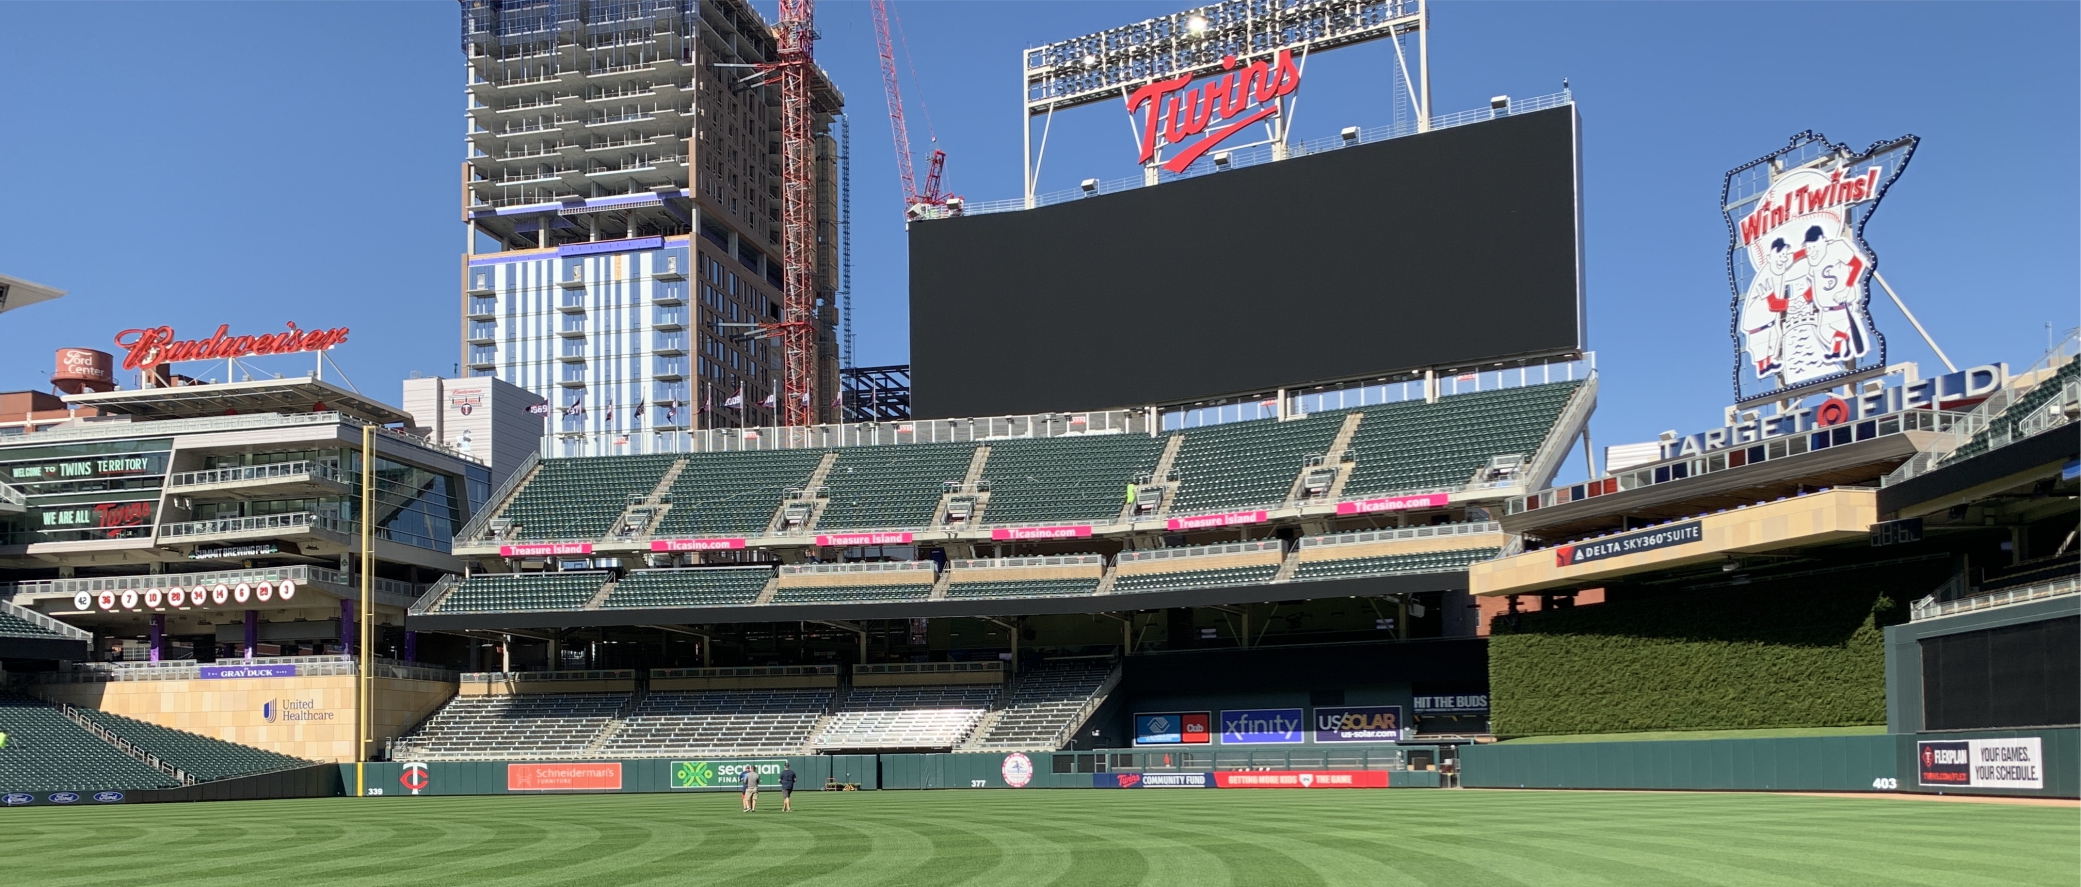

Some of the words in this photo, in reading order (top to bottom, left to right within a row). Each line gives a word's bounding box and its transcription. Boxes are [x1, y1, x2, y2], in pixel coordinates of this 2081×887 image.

[1127, 49, 1299, 173] Twins
[1740, 192, 1793, 245] Win!
[1797, 168, 1876, 214] Twins!
[114, 321, 349, 370] Budweiser
[63, 350, 93, 366] Ford
[68, 364, 105, 377] Center
[1659, 406, 1812, 460] TARGET
[1858, 365, 2003, 419] FIELD
[13, 466, 42, 477] WELCOME
[60, 461, 92, 477] TWINS
[97, 457, 148, 473] TERRITORY
[43, 512, 57, 526] WE
[58, 511, 74, 524] ARE
[75, 510, 90, 523] ALL
[94, 501, 151, 537] Twins
[1178, 518, 1222, 529] Treasure
[1225, 512, 1257, 524] Island
[826, 536, 870, 545] Treasure
[872, 534, 903, 544] Island
[196, 548, 222, 560] SUMMIT
[223, 546, 255, 558] BREWING
[256, 544, 270, 554] PUB
[510, 546, 551, 555] Treasure
[553, 544, 583, 554] Island
[1586, 542, 1621, 558] DELTA
[217, 590, 225, 599] 14
[240, 588, 245, 597] 6
[261, 587, 270, 596] 29
[285, 585, 290, 594] 3
[79, 596, 88, 605] 42
[103, 595, 112, 604] 36
[127, 595, 133, 603] 7
[150, 594, 158, 602] 10
[172, 592, 181, 601] 28
[195, 591, 204, 600] 34
[246, 669, 273, 677] DUCK
[282, 699, 314, 710] United
[1413, 696, 1432, 708] HIT
[1433, 696, 1455, 708] THE
[1456, 695, 1488, 708] BUDS
[282, 710, 334, 721] Healthcare
[1187, 723, 1204, 733] Cub
[1226, 714, 1299, 740] xfinity
[1341, 730, 1396, 738] us-solar.com
[1981, 747, 1999, 762] YOUR
[2001, 746, 2031, 762] GAMES.
[536, 767, 614, 778] Schneiderman's
[1975, 766, 1995, 780] YOUR
[1996, 765, 2039, 781] SCHEDULE.
[971, 780, 986, 788] 377
[1117, 773, 1141, 788] Twins
[1142, 776, 1185, 785] COMMUNITY
[1186, 775, 1206, 784] FUND
[1228, 775, 1258, 785] GETTING
[1259, 775, 1279, 784] MORE
[1280, 775, 1298, 784] KIDS
[1315, 775, 1329, 783] THE
[1331, 775, 1352, 784] GAME
[1872, 778, 1897, 789] 403
[8, 793, 28, 802] Ford
[54, 792, 75, 802] Ford
[98, 792, 117, 800] Ford
